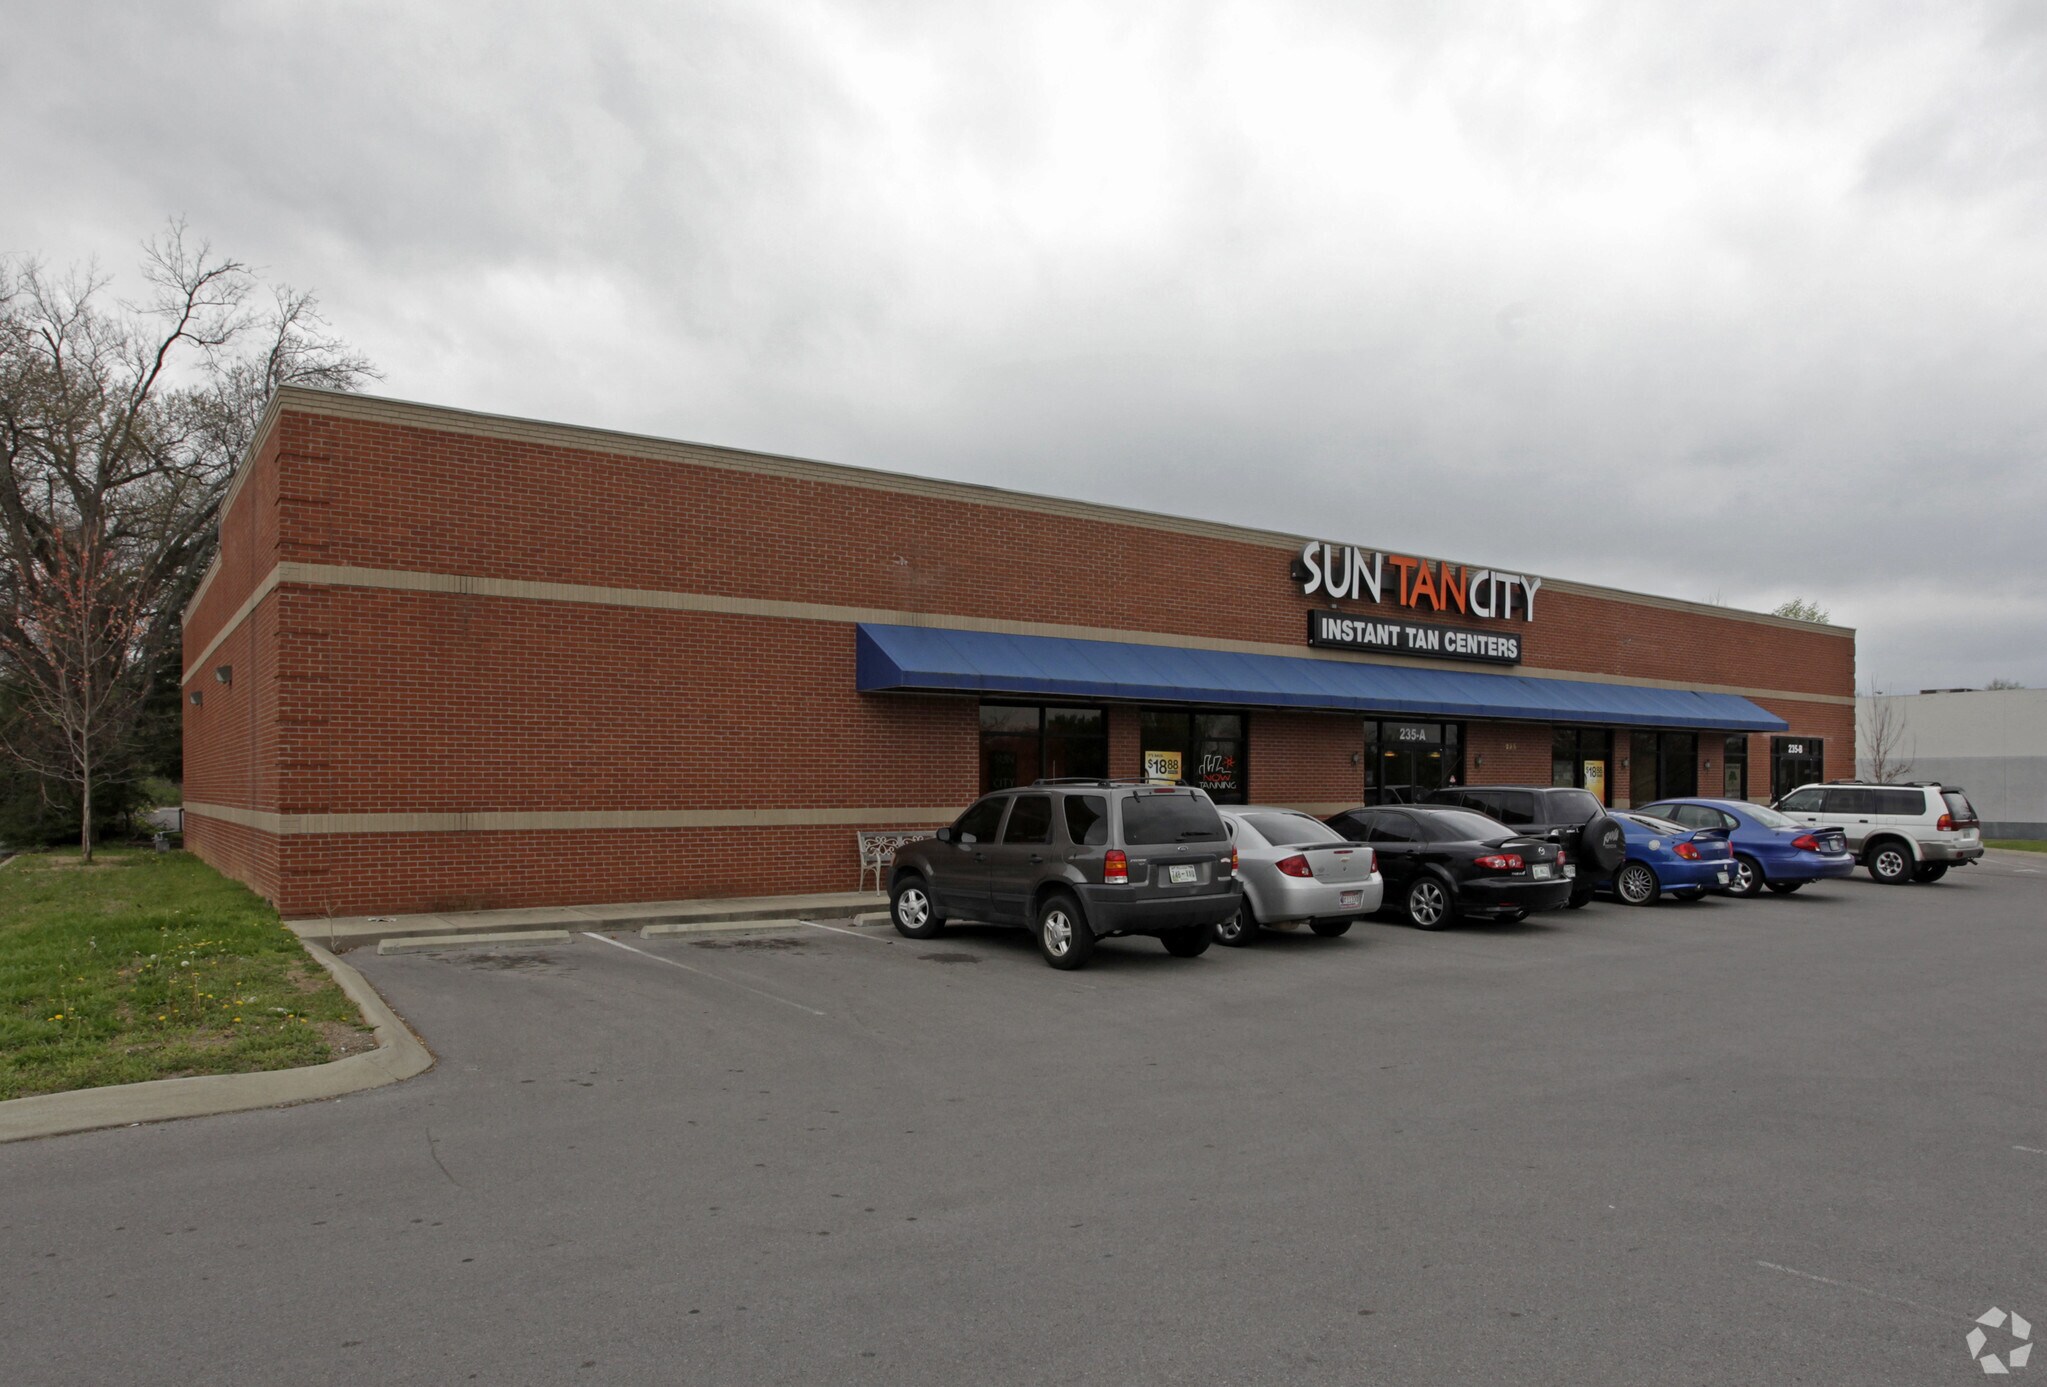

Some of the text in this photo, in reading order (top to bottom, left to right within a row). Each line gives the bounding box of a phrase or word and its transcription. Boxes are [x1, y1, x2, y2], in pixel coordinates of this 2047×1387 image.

[1303, 540, 1542, 622] SUN TAN CITY
[1321, 617, 1518, 659] INSTANT TAN CENTERS
[1399, 728, 1426, 741] 235-A
[1787, 744, 1803, 754] 235-B
[1203, 774, 1231, 782] NOW
[1199, 781, 1237, 789] TANNING
